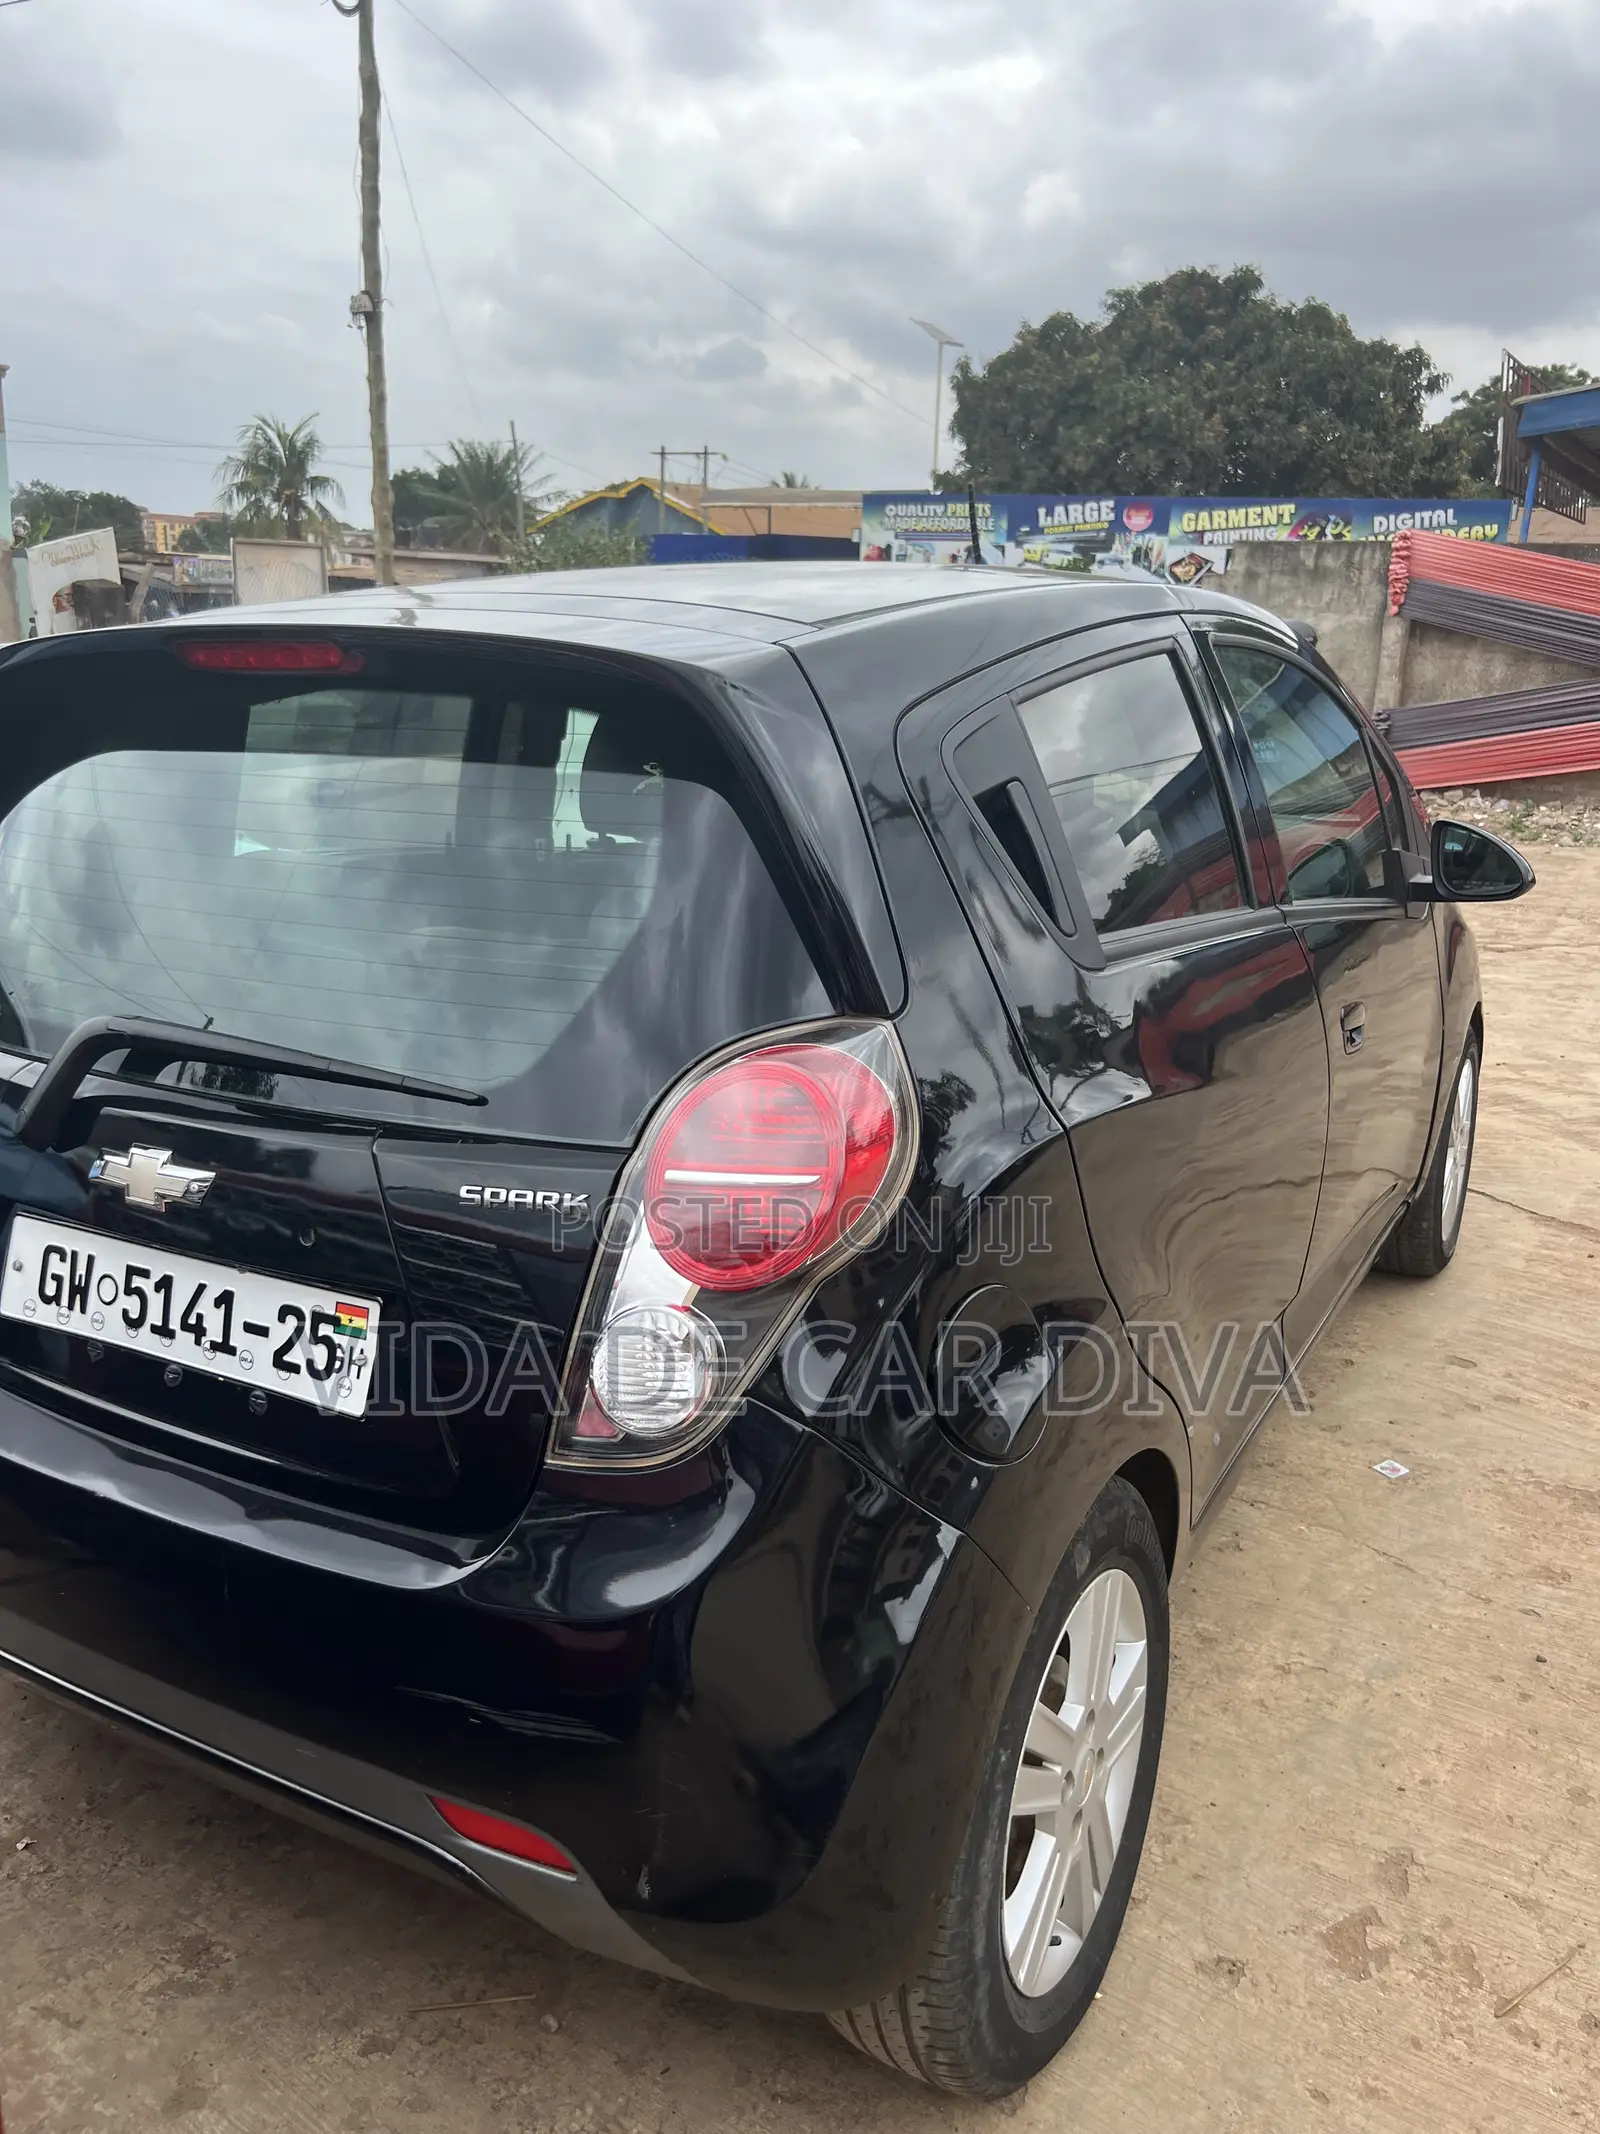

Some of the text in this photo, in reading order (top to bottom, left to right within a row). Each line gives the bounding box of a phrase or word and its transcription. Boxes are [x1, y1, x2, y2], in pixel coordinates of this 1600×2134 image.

[884, 503, 992, 518] QUALITY PRITS
[1037, 500, 1116, 528] LARGE
[1182, 503, 1296, 532] GARMENT
[1373, 508, 1459, 534] DIGITAL
[459, 1185, 591, 1216] SPARK
[38, 1244, 342, 1381] GW 5141-25
